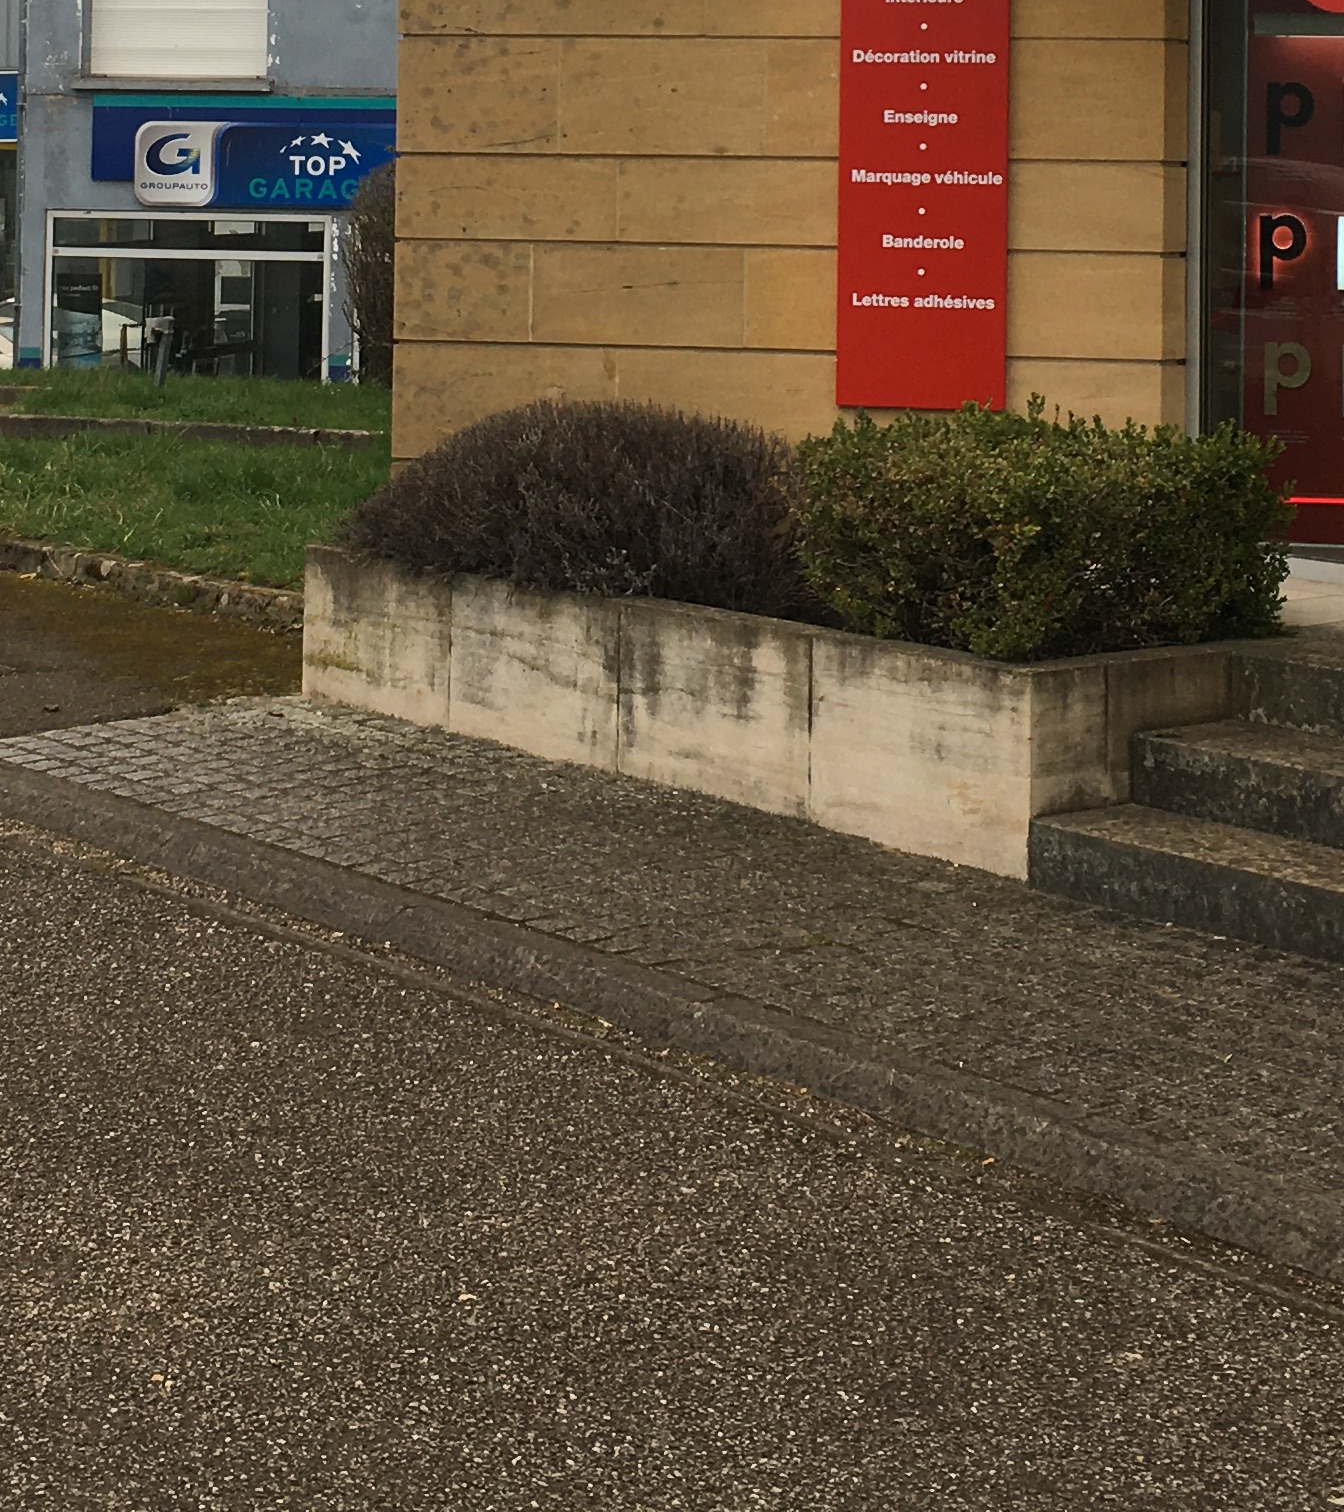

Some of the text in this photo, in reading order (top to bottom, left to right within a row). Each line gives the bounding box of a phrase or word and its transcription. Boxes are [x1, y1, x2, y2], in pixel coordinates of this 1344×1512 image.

[852, 50, 996, 64] Décoration vitrine
[883, 110, 958, 126] Enseigne
[1266, 82, 1314, 155] p
[290, 155, 346, 176] TOP
[851, 169, 1003, 186] Marquage véhicule
[141, 182, 209, 191] GROUPAUTO
[249, 177, 359, 199] GARAG
[882, 235, 964, 249] Banderole
[1260, 215, 1306, 288] p
[852, 293, 995, 309] Lettres adhésives
[1264, 341, 1312, 415] p
